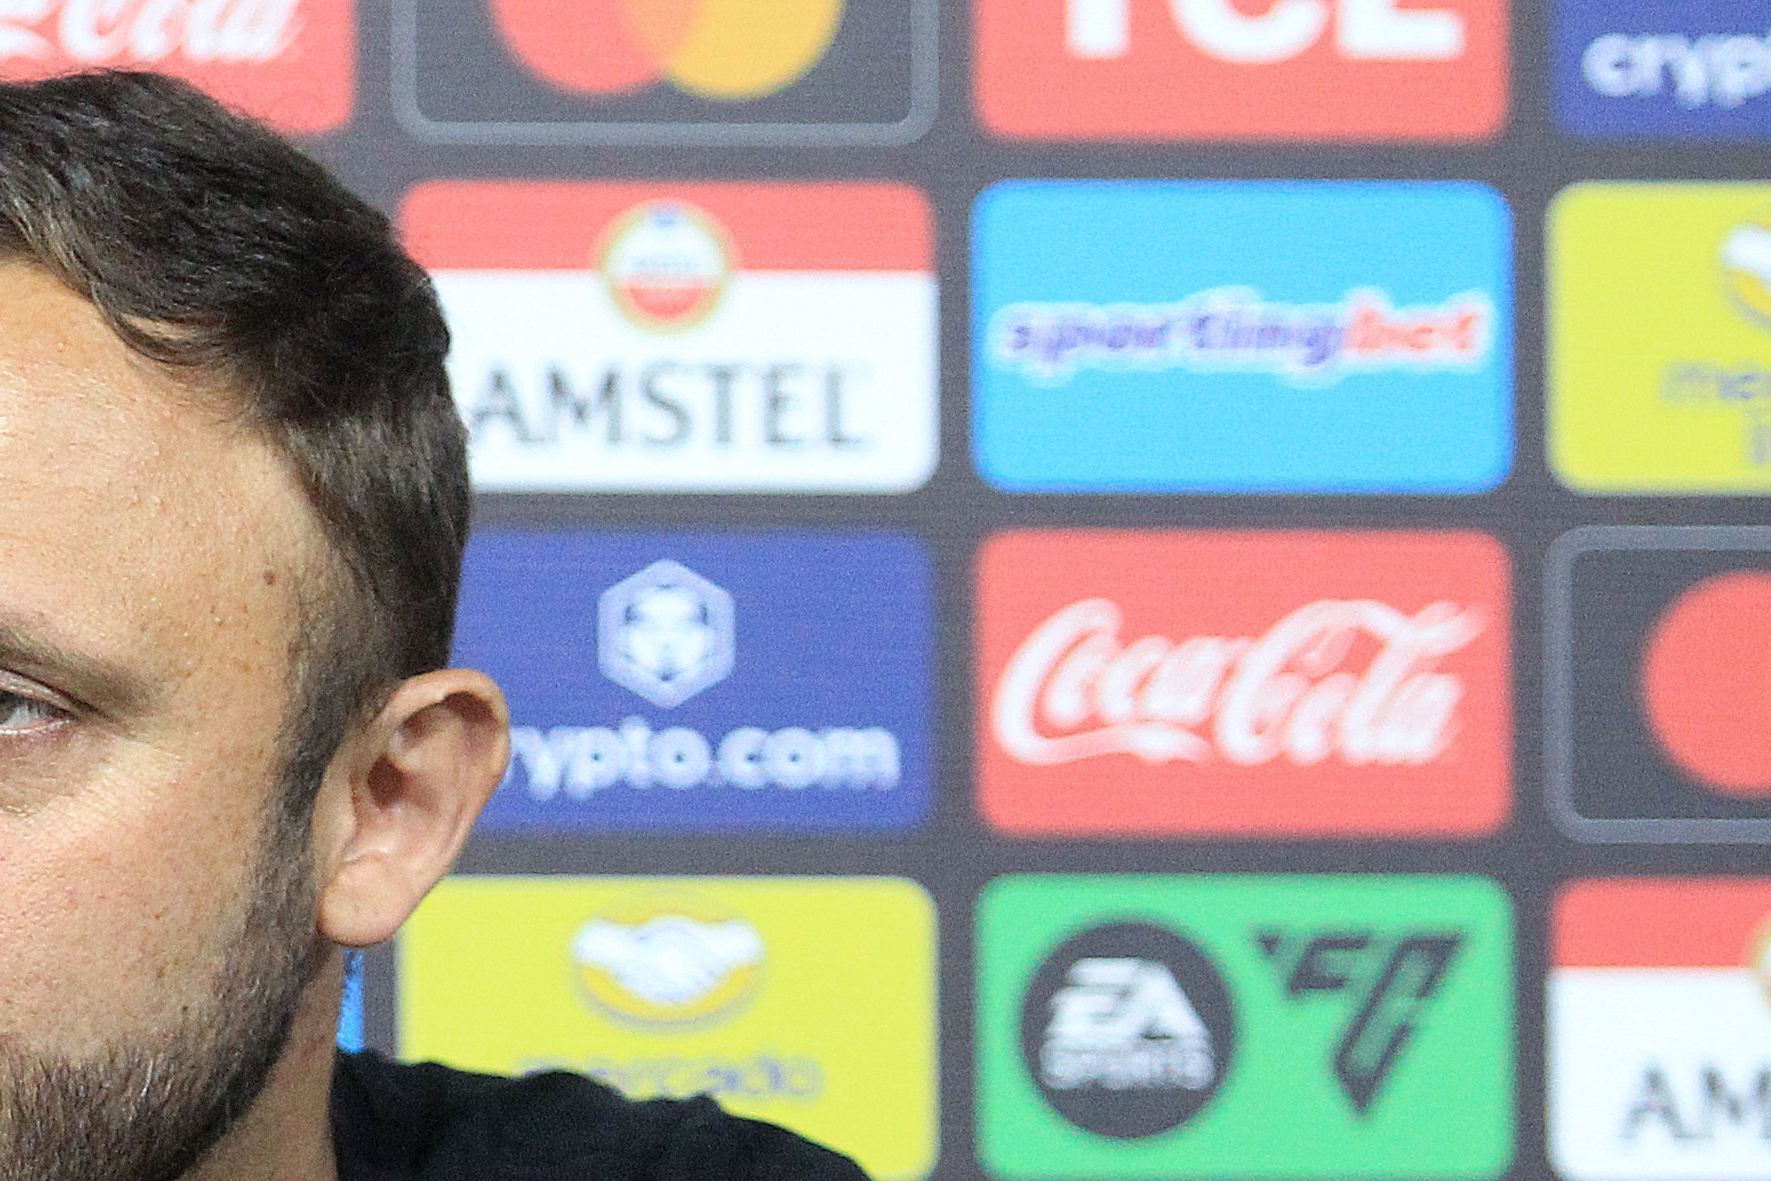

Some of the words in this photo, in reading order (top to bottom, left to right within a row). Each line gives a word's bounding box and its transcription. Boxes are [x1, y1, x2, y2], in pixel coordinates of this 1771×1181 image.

[1580, 32, 1771, 109] cryp
[472, 360, 870, 448] AMSTEL
[994, 598, 1490, 765] Coca-Cola
